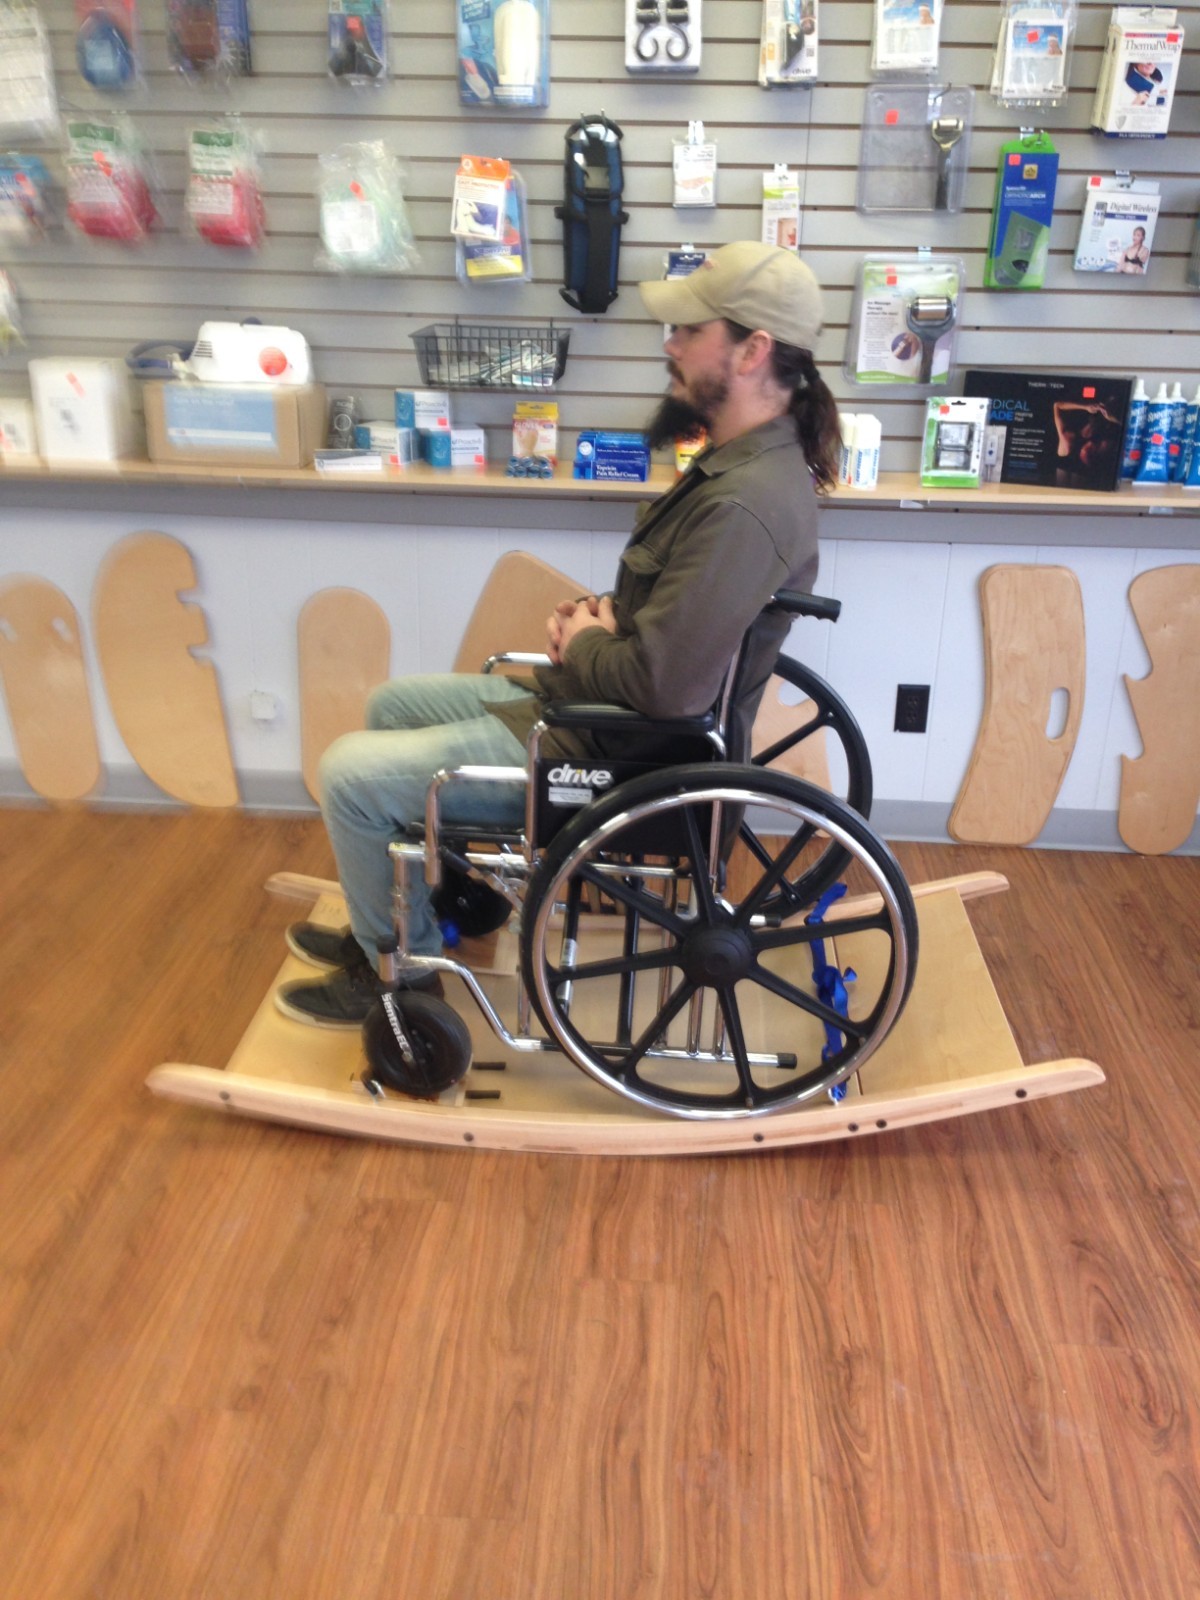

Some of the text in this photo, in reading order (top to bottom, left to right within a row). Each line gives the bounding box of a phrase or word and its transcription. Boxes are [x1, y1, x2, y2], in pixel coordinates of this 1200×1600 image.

[1110, 202, 1157, 213] Digital Wireless
[988, 399, 1031, 412] EDICAL
[547, 763, 612, 786] drive
